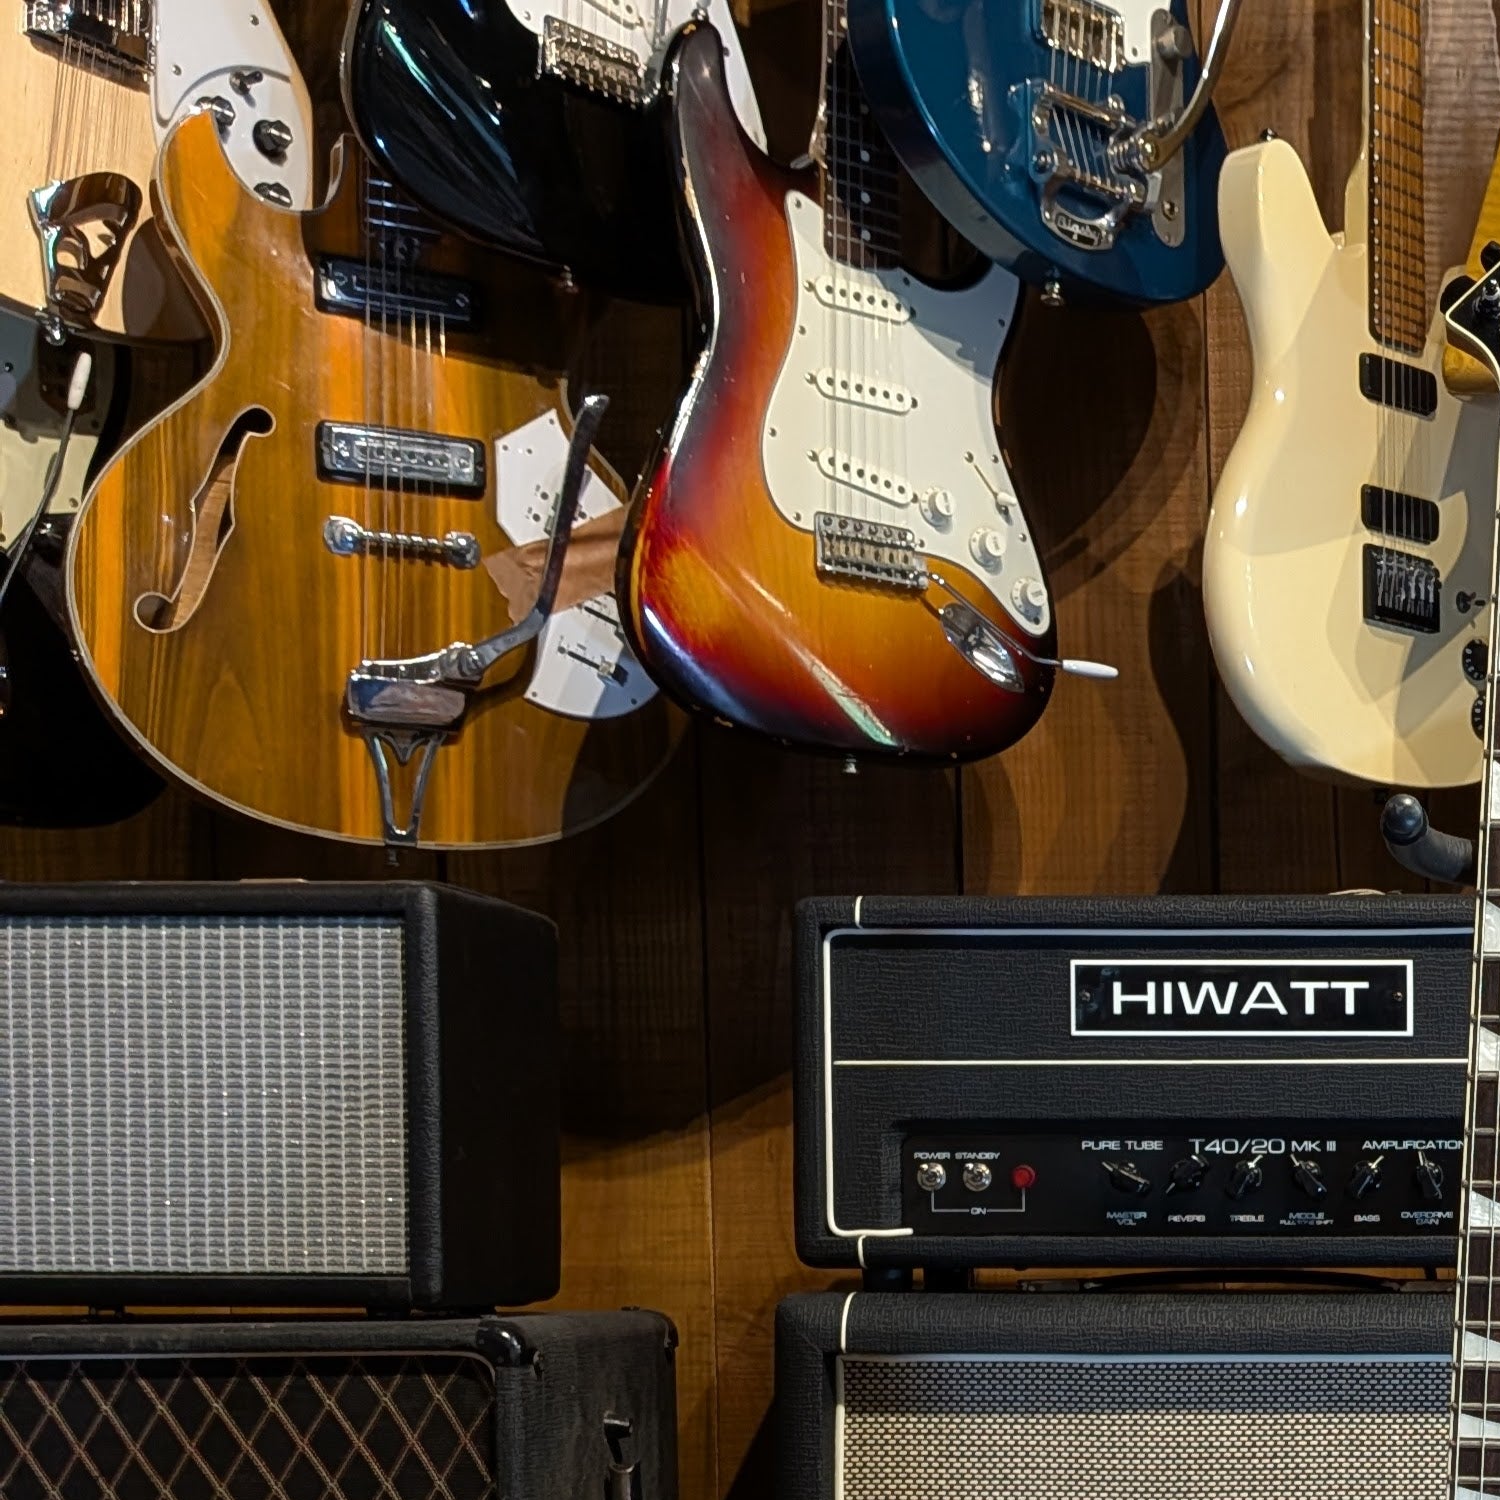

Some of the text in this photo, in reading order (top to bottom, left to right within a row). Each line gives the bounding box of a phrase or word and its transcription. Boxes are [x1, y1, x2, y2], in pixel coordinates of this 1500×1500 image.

[1112, 981, 1370, 1016] HIWATT
[1081, 1140, 1164, 1151] PURE TUBE
[1189, 1138, 1337, 1155] T40/20 MK III
[913, 1151, 951, 1160] POWER
[954, 1151, 1001, 1160] STANDBY
[970, 1207, 987, 1216] ON
[1106, 1211, 1148, 1220] MASTER
[1400, 1211, 1454, 1220] OVERDRIVE
[1167, 1214, 1206, 1223] REVERB
[1229, 1214, 1265, 1223] TREBLE
[1353, 1214, 1381, 1223] BASS
[1415, 1218, 1440, 1226] GAIN
